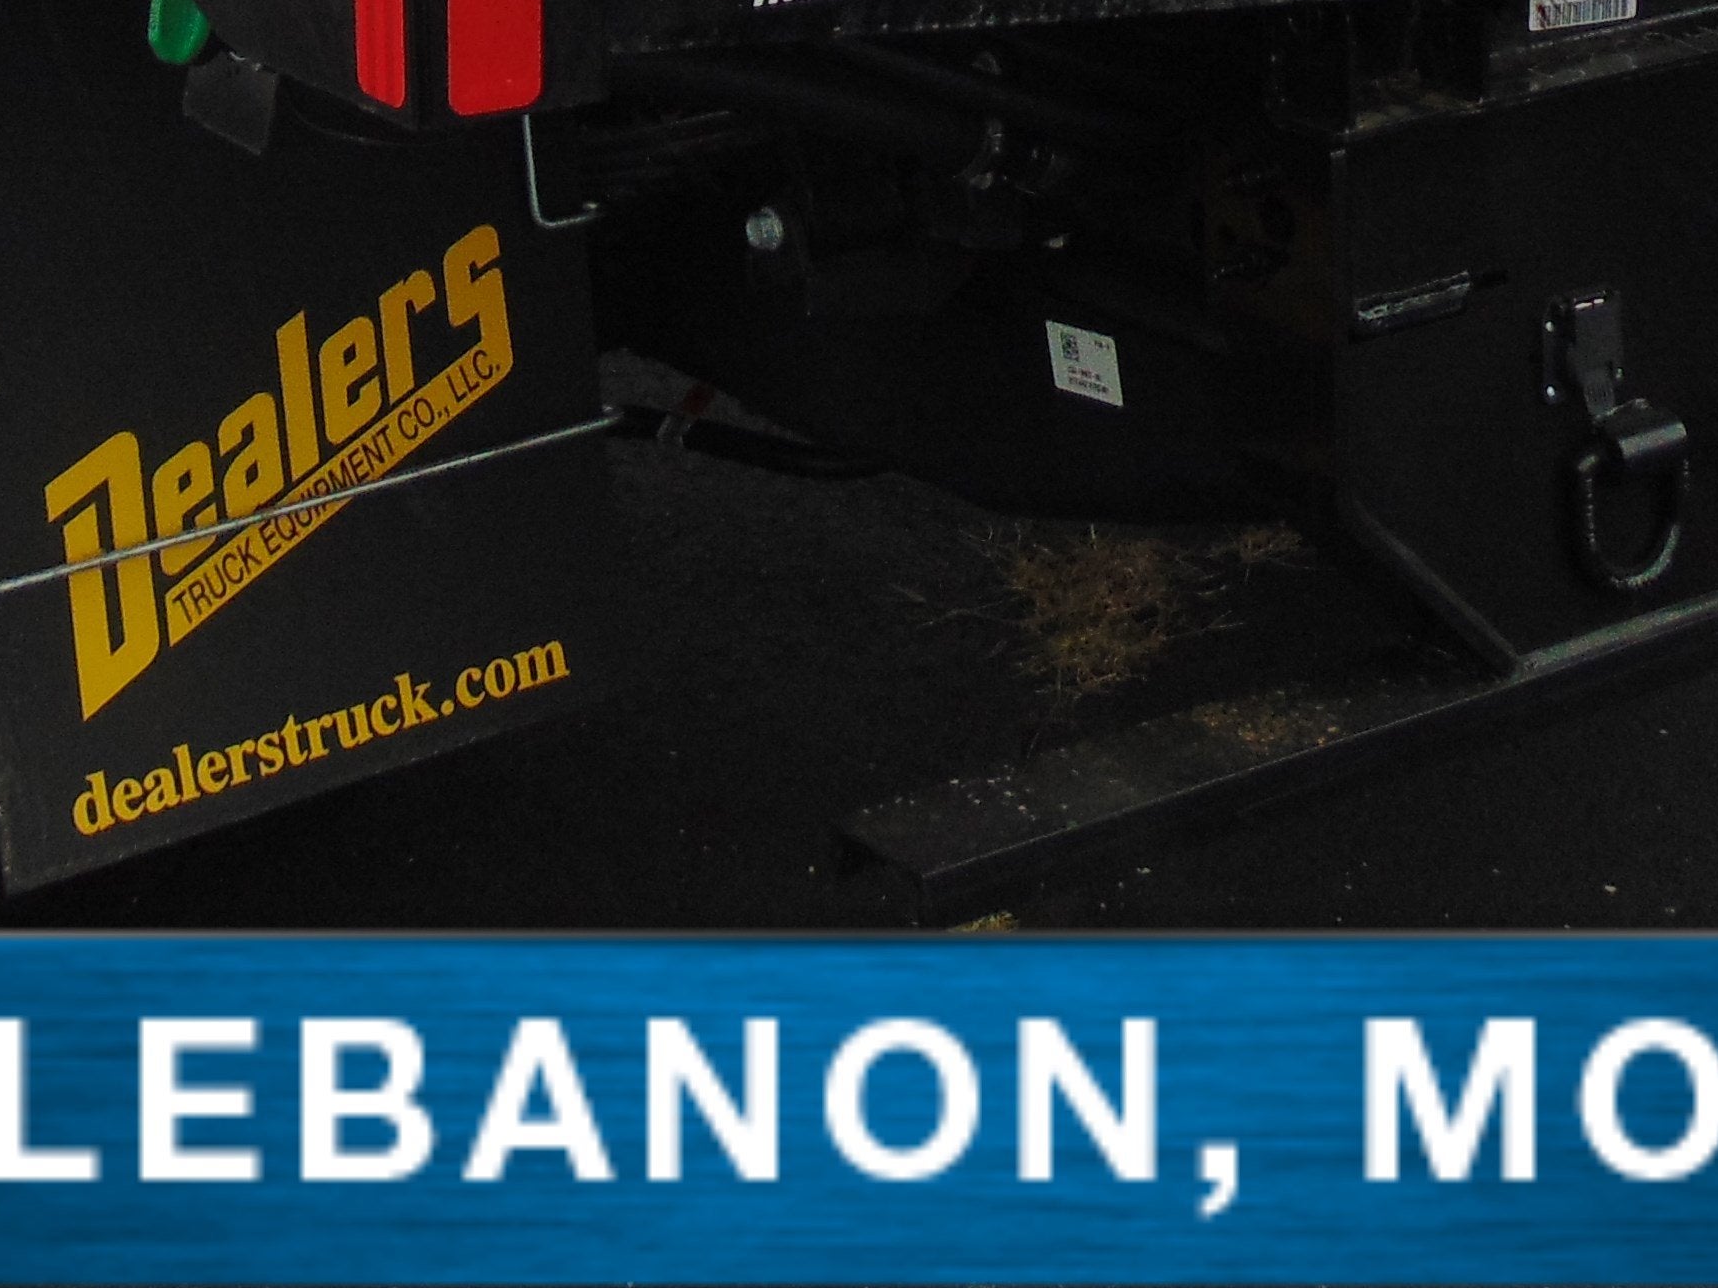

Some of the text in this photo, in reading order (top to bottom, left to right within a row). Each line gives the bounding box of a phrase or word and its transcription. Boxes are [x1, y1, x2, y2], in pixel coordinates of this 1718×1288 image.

[43, 223, 514, 722] Dealers
[171, 536, 263, 624] TRUCK
[258, 423, 399, 556] EQUIPMENT
[445, 348, 502, 404] LLC.
[70, 638, 571, 838] dealerstruck.com
